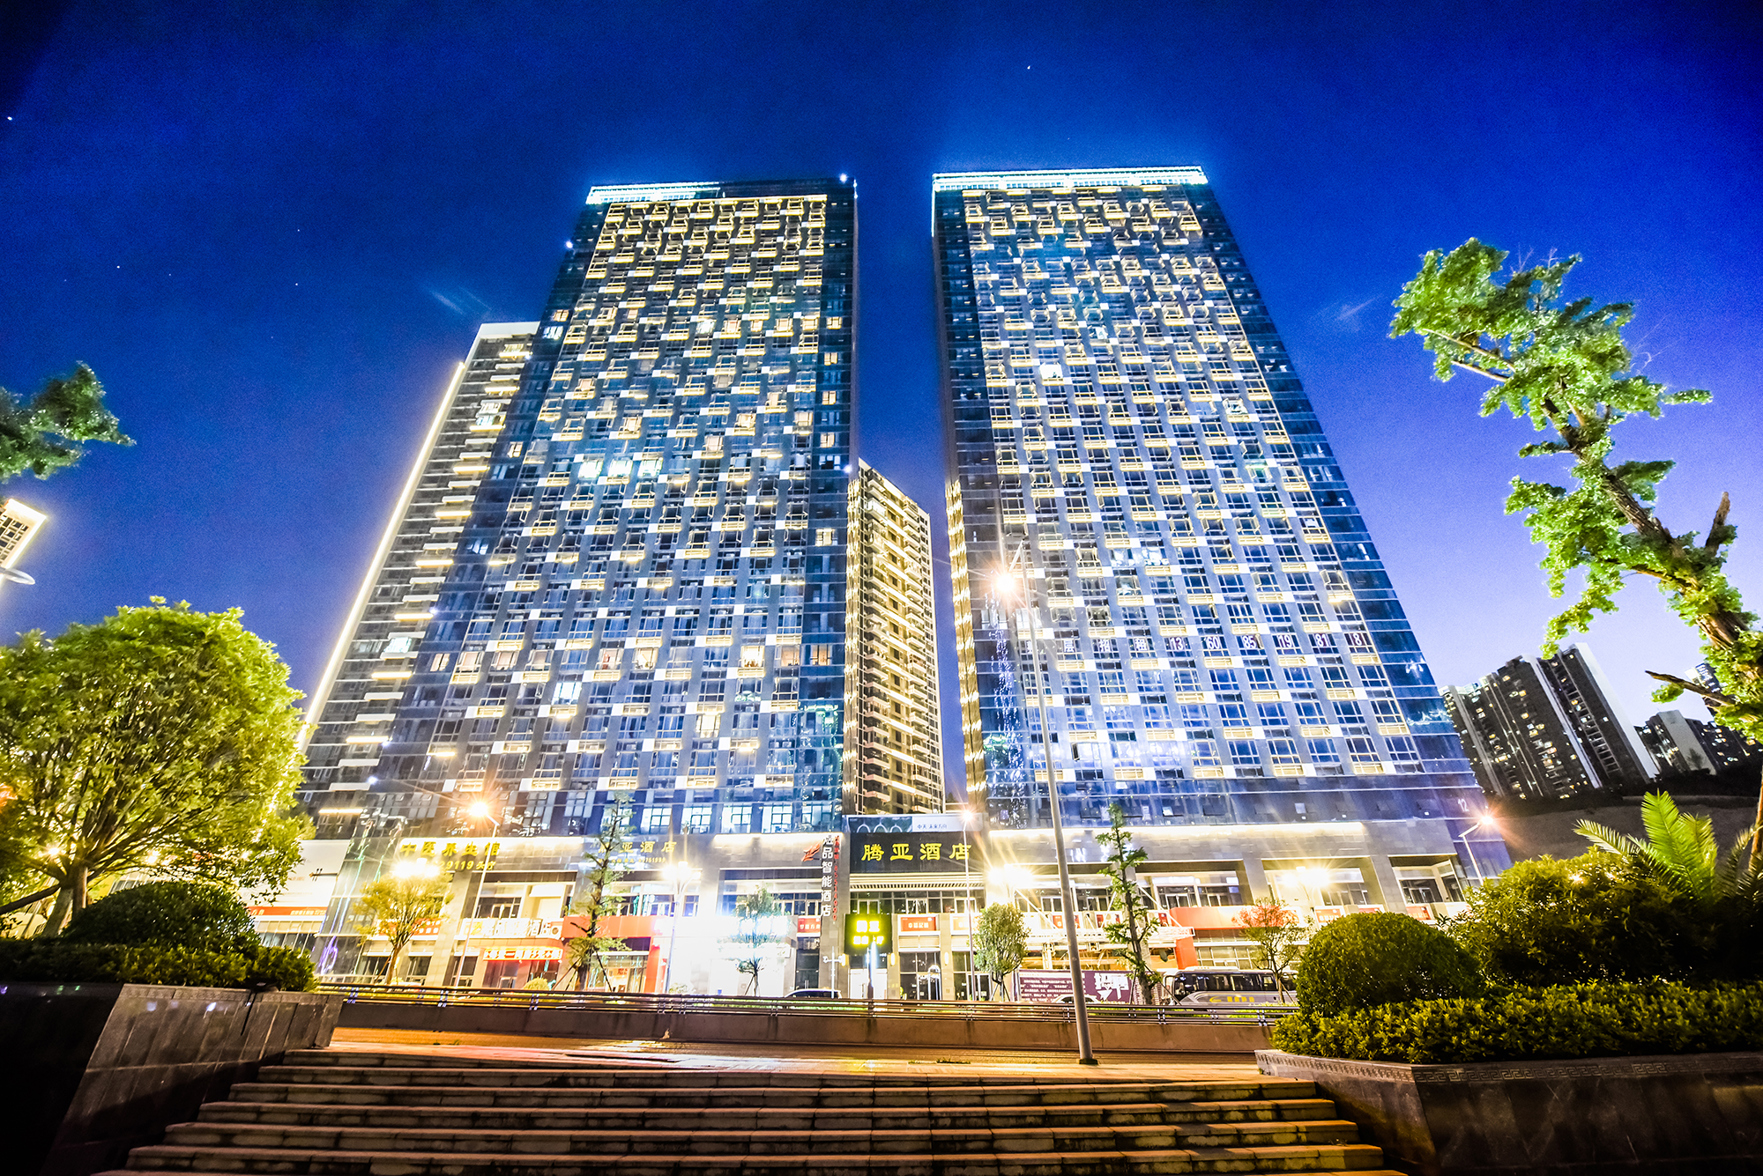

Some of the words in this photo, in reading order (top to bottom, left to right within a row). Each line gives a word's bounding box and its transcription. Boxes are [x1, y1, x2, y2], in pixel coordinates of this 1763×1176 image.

[400, 841, 501, 857] 中医养生馆
[861, 843, 972, 861] 腾亚酒店
